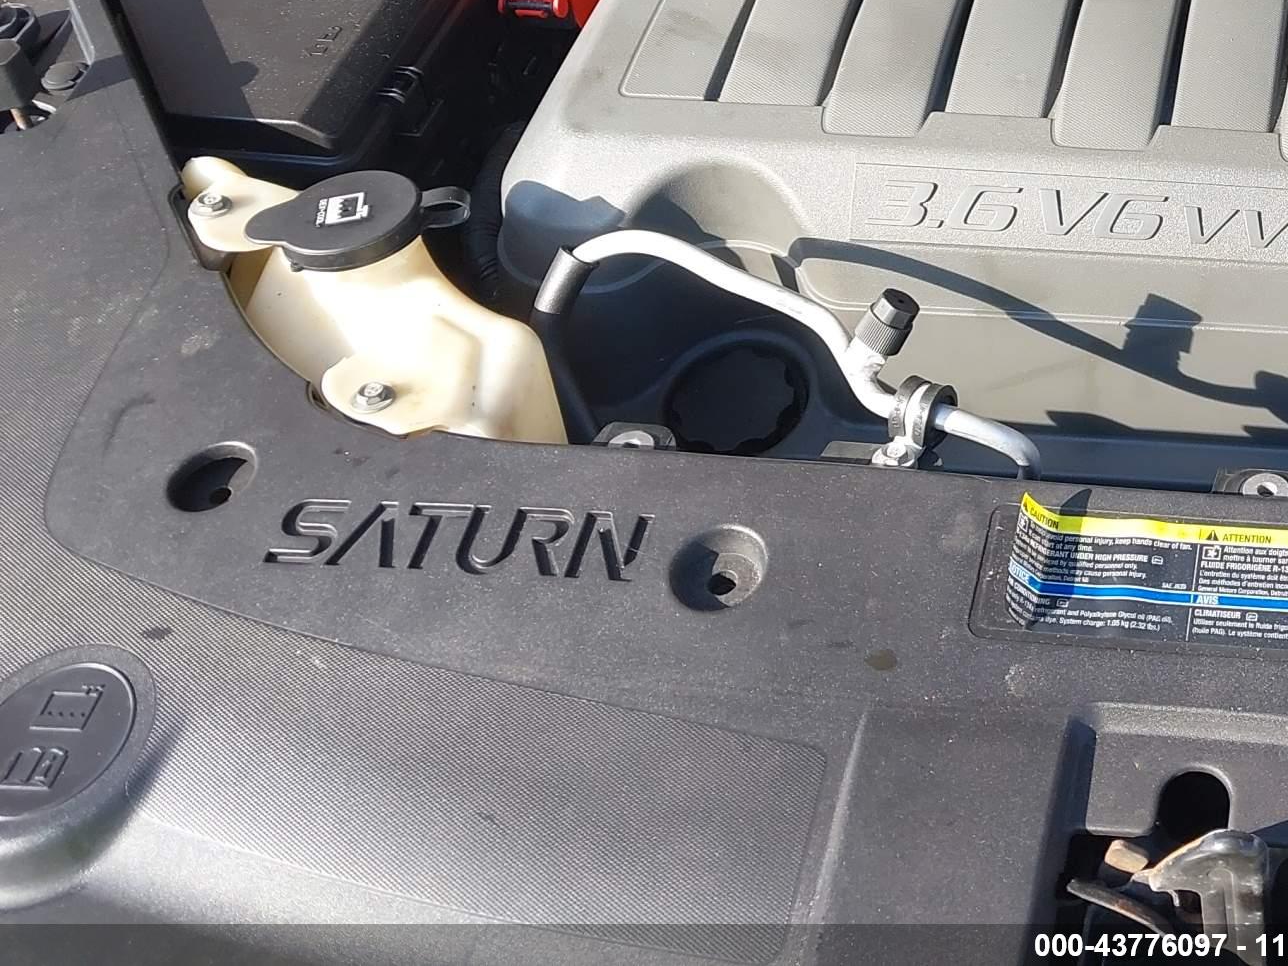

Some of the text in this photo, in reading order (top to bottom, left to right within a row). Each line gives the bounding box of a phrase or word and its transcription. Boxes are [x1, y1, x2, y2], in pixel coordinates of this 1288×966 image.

[866, 179, 1024, 231] 3.6
[1039, 187, 1169, 240] V6
[1030, 507, 1059, 529] CAUTION
[263, 497, 656, 582] SATURN
[1132, 538, 1153, 546] hands
[1222, 533, 1272, 543] ATTENTION
[1224, 545, 1254, 555] Attention
[1255, 547, 1267, 555] aux
[1095, 553, 1112, 561] HIGH
[1113, 554, 1149, 562] PRESSURE
[1223, 554, 1245, 563] mettre
[1252, 556, 1276, 564] tourner
[1201, 561, 1225, 570] FLUIDE
[1196, 595, 1219, 605] AVIS
[1194, 608, 1242, 619] CLIMATISEUR
[1059, 617, 1082, 625] System
[1083, 619, 1106, 627] charge:
[1130, 621, 1147, 629] (2.32
